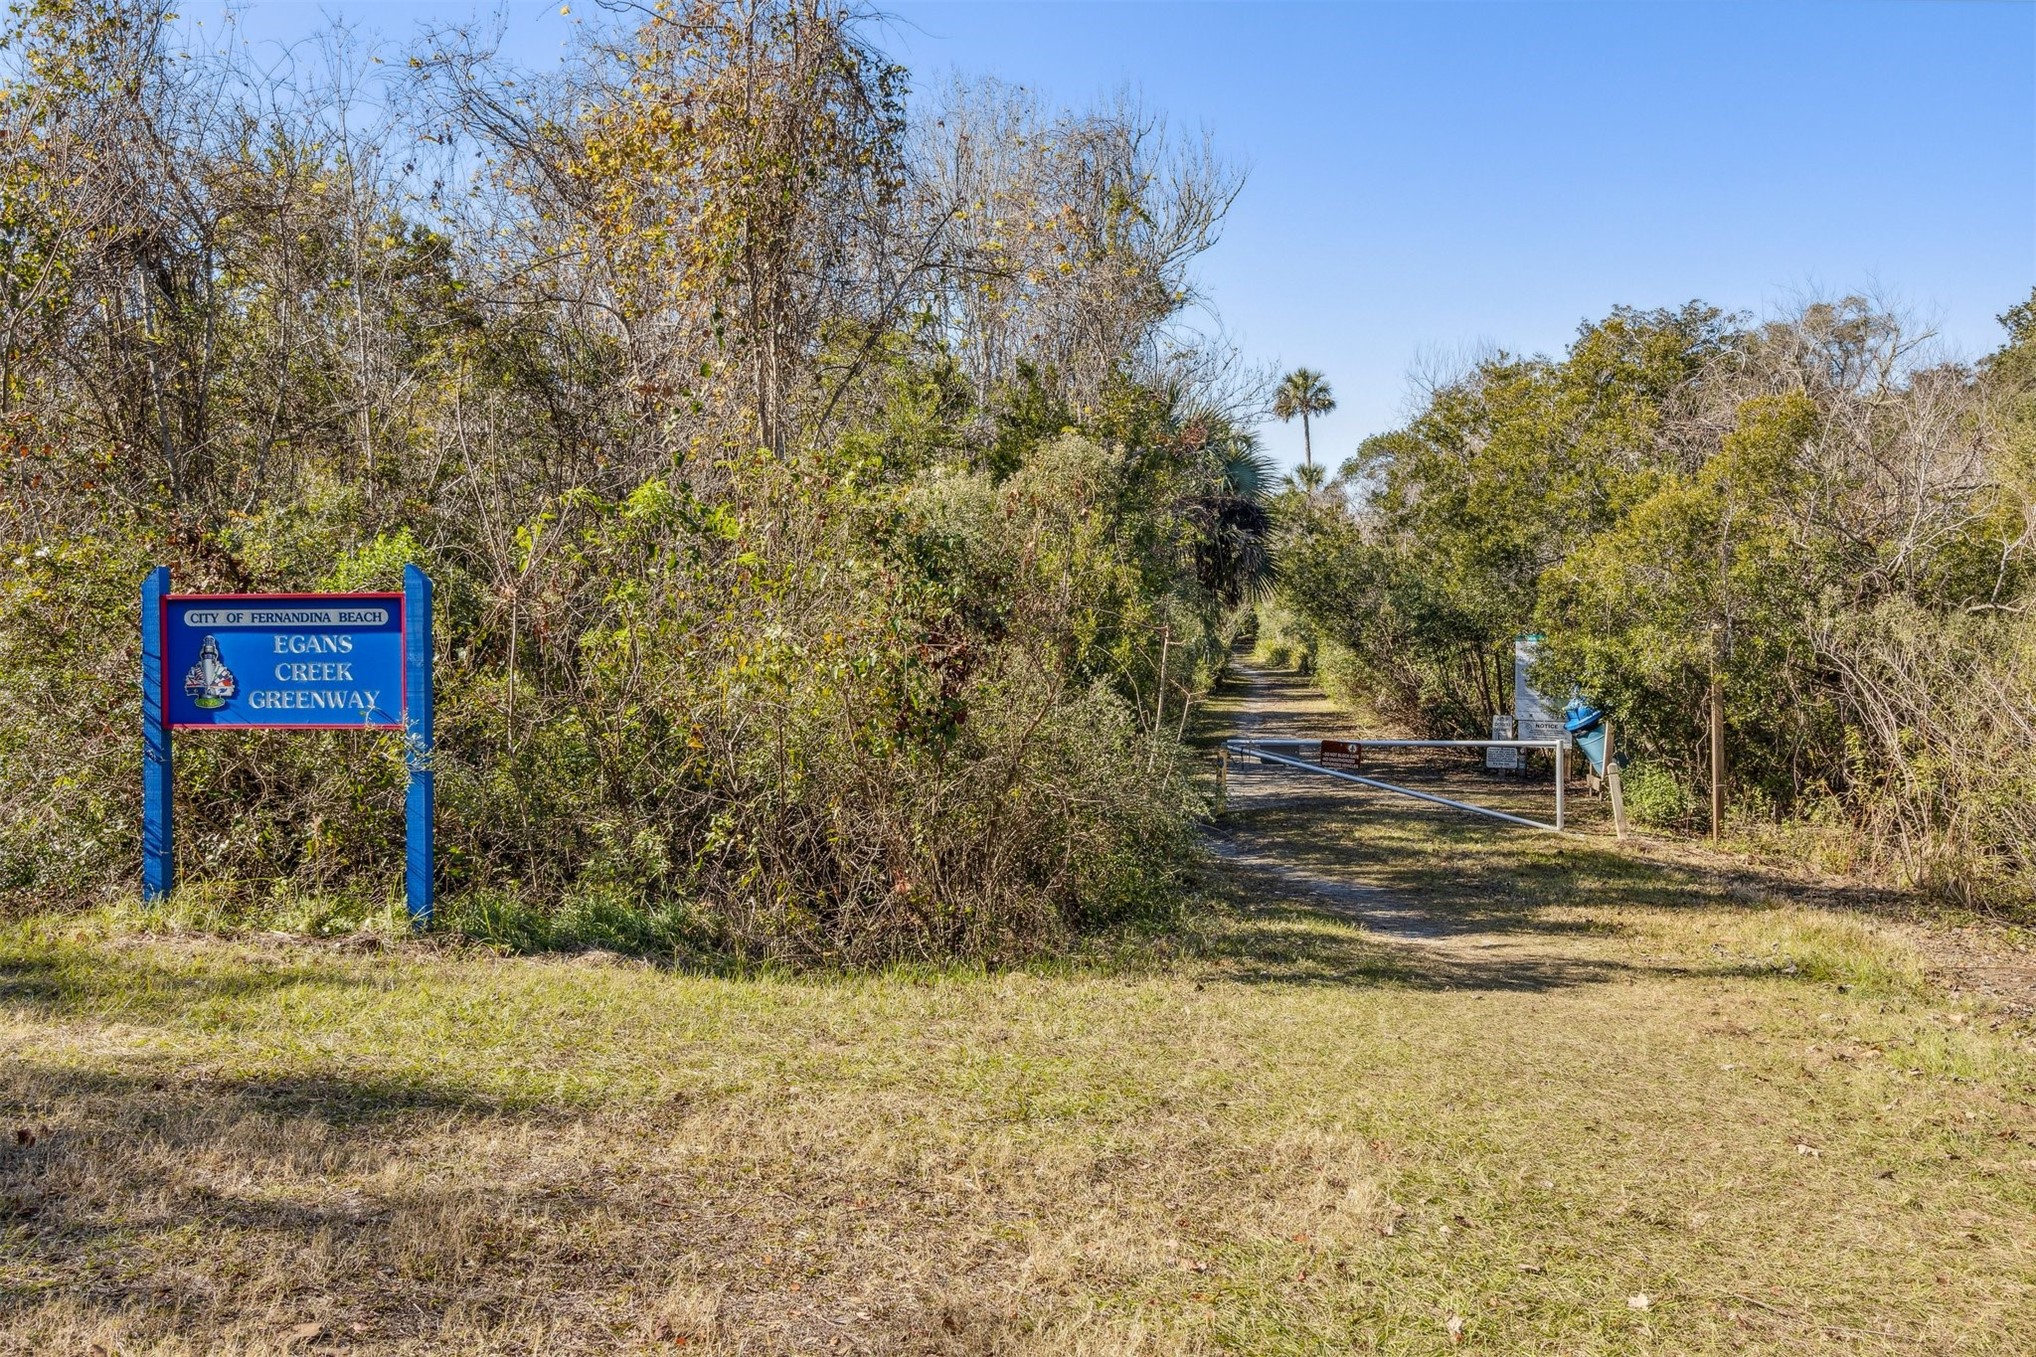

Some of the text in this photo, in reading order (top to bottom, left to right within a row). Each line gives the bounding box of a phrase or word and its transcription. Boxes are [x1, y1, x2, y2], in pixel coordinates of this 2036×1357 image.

[190, 612, 382, 623] CITY OF FERNANDINA BEACH
[273, 634, 353, 654] EGANS
[274, 662, 354, 682] CREEK
[248, 690, 380, 709] GREENWAY
